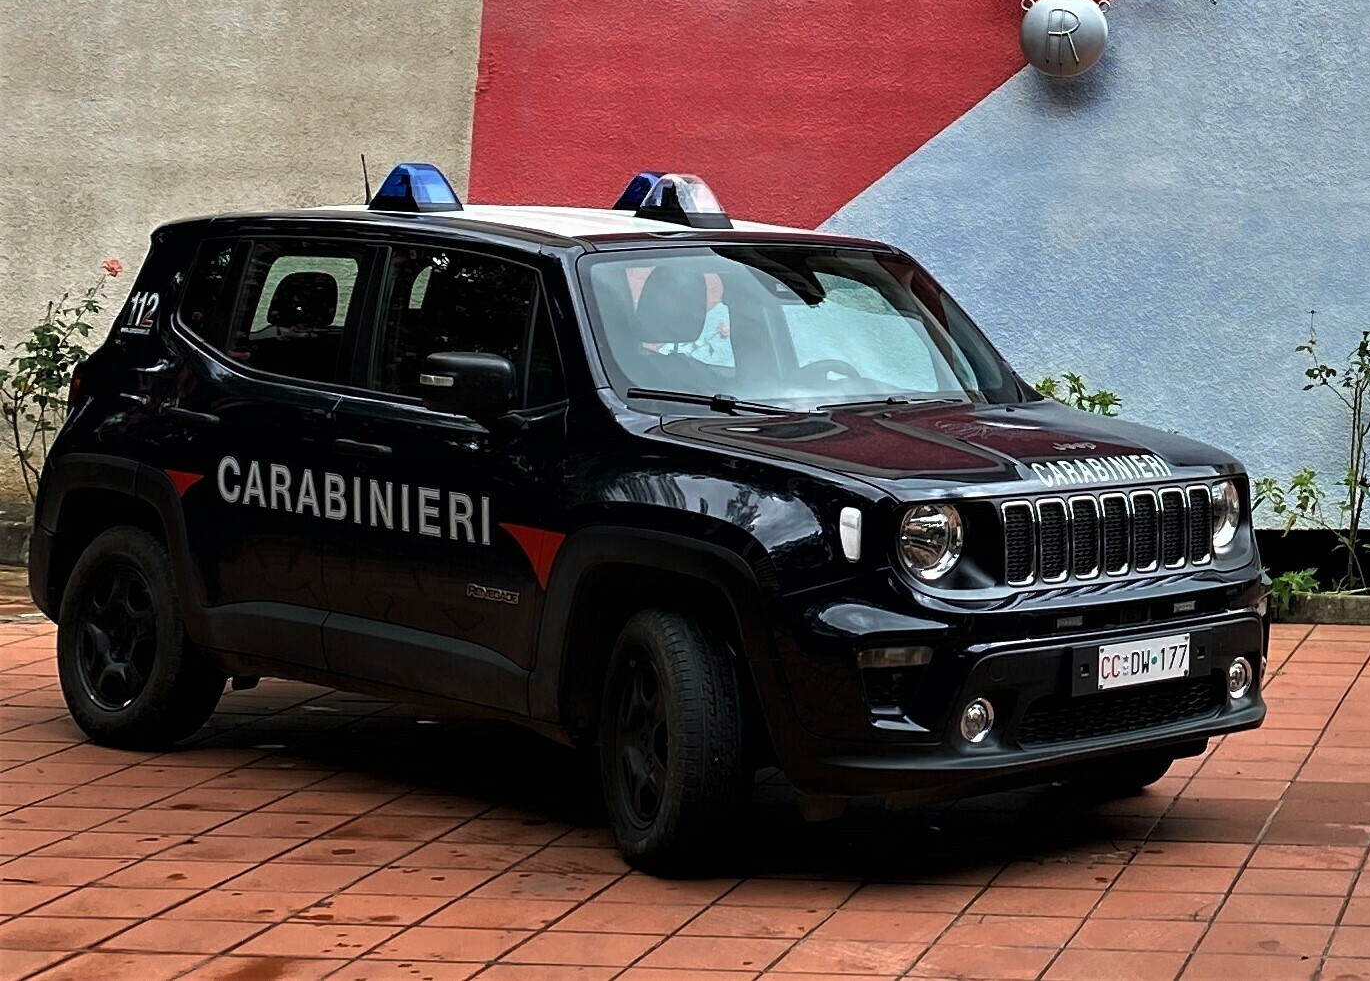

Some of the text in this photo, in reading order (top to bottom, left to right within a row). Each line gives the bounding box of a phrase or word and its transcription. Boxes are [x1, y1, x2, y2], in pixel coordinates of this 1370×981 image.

[127, 291, 160, 328] 112
[1031, 453, 1172, 488] CARABINIERI
[217, 455, 491, 546] CARABINIERI
